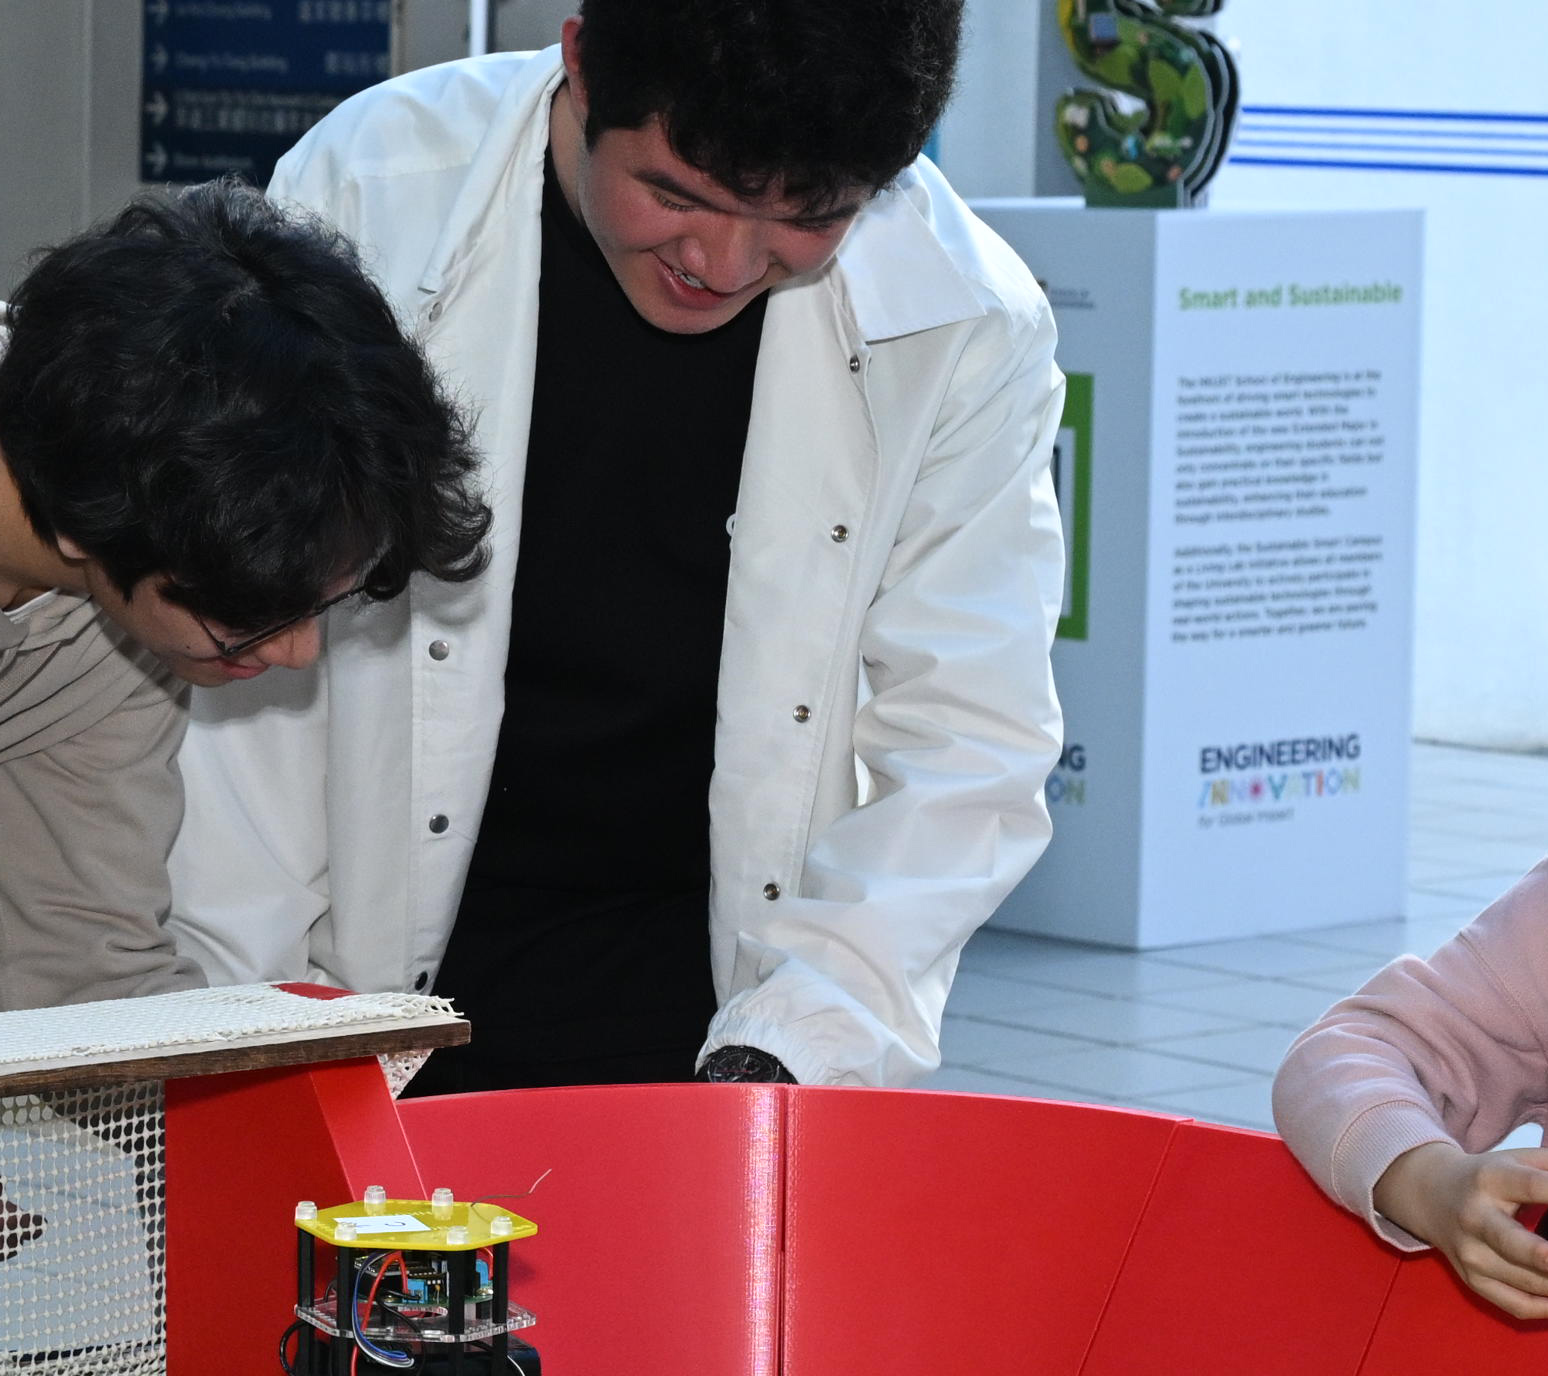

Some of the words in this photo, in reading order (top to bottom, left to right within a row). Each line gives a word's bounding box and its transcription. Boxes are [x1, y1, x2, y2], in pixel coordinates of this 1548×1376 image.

[1179, 286, 1237, 310] Smart
[1245, 283, 1283, 307] and
[1289, 280, 1403, 306] Sustainable
[1201, 733, 1362, 774] ENGINEERING
